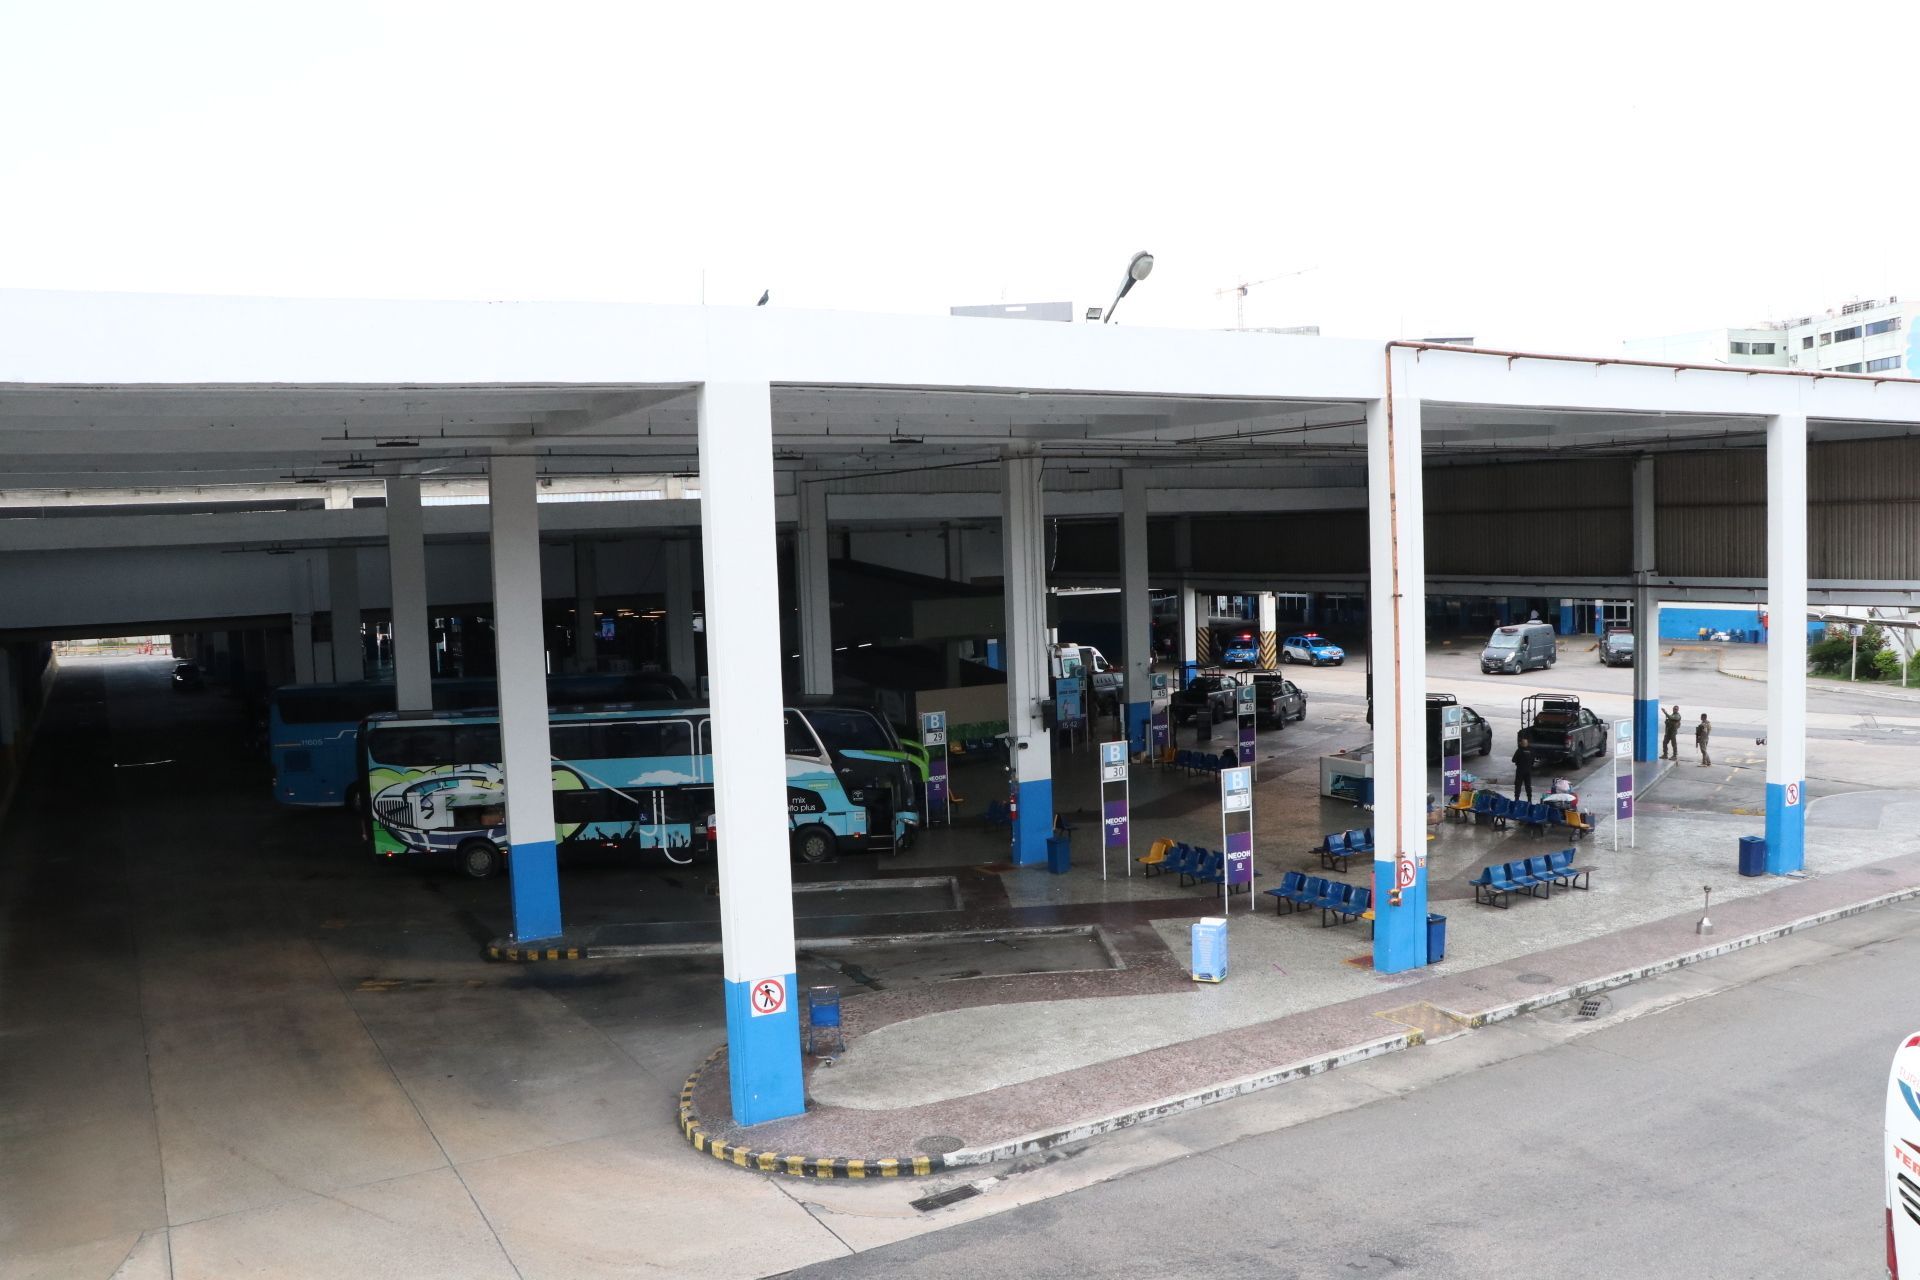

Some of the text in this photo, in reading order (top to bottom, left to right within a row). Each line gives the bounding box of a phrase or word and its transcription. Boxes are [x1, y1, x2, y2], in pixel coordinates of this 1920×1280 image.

[1154, 674, 1163, 687] C
[1242, 687, 1252, 700] C
[1448, 708, 1458, 722] C
[930, 714, 940, 729] B
[933, 732, 943, 742] 29
[1110, 745, 1121, 761] B
[1113, 767, 1124, 777] 30
[1231, 771, 1243, 790] B
[792, 796, 806, 804] mix
[1237, 795, 1249, 807] 31
[800, 804, 816, 813] plus
[1227, 849, 1251, 860] NEOOH
